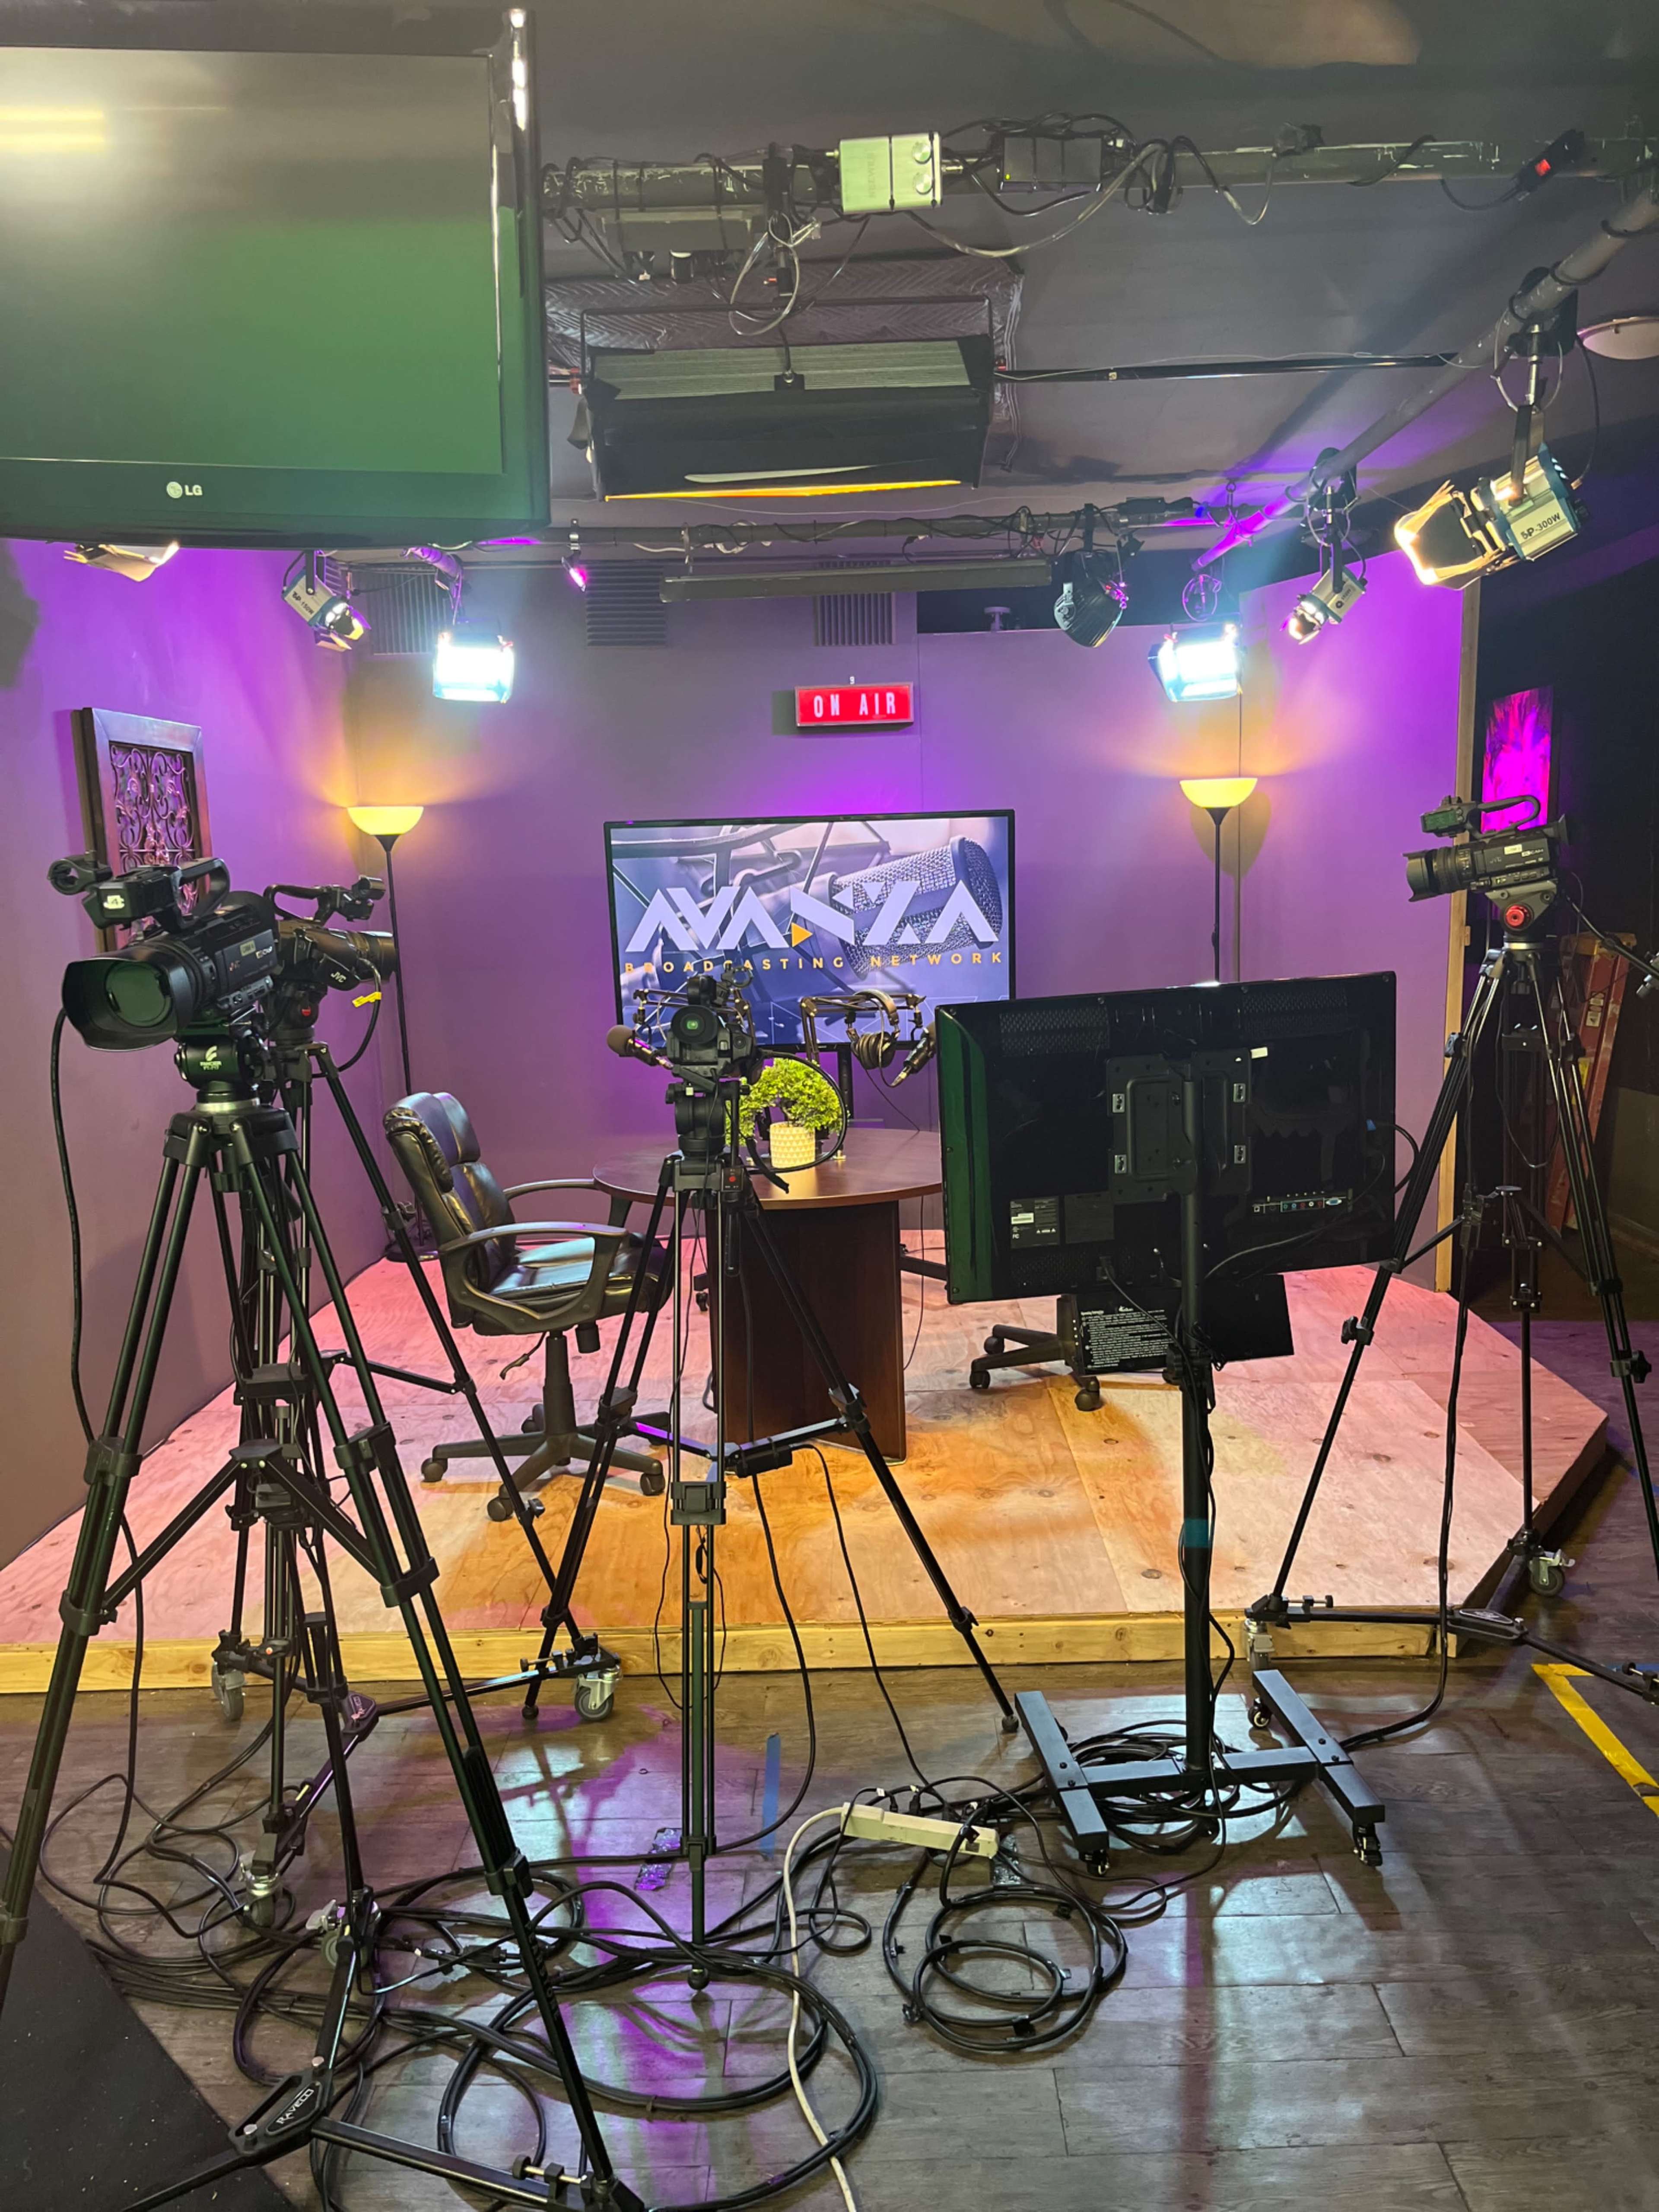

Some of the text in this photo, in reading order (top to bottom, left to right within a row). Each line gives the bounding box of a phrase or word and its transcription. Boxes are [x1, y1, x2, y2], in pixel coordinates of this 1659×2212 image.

[184, 484, 203, 496] LG
[814, 692, 896, 718] ON AIR
[626, 880, 999, 952] AVANZA
[625, 952, 1001, 974] BROADCASTING NETWORK
[331, 972, 346, 982] JVC
